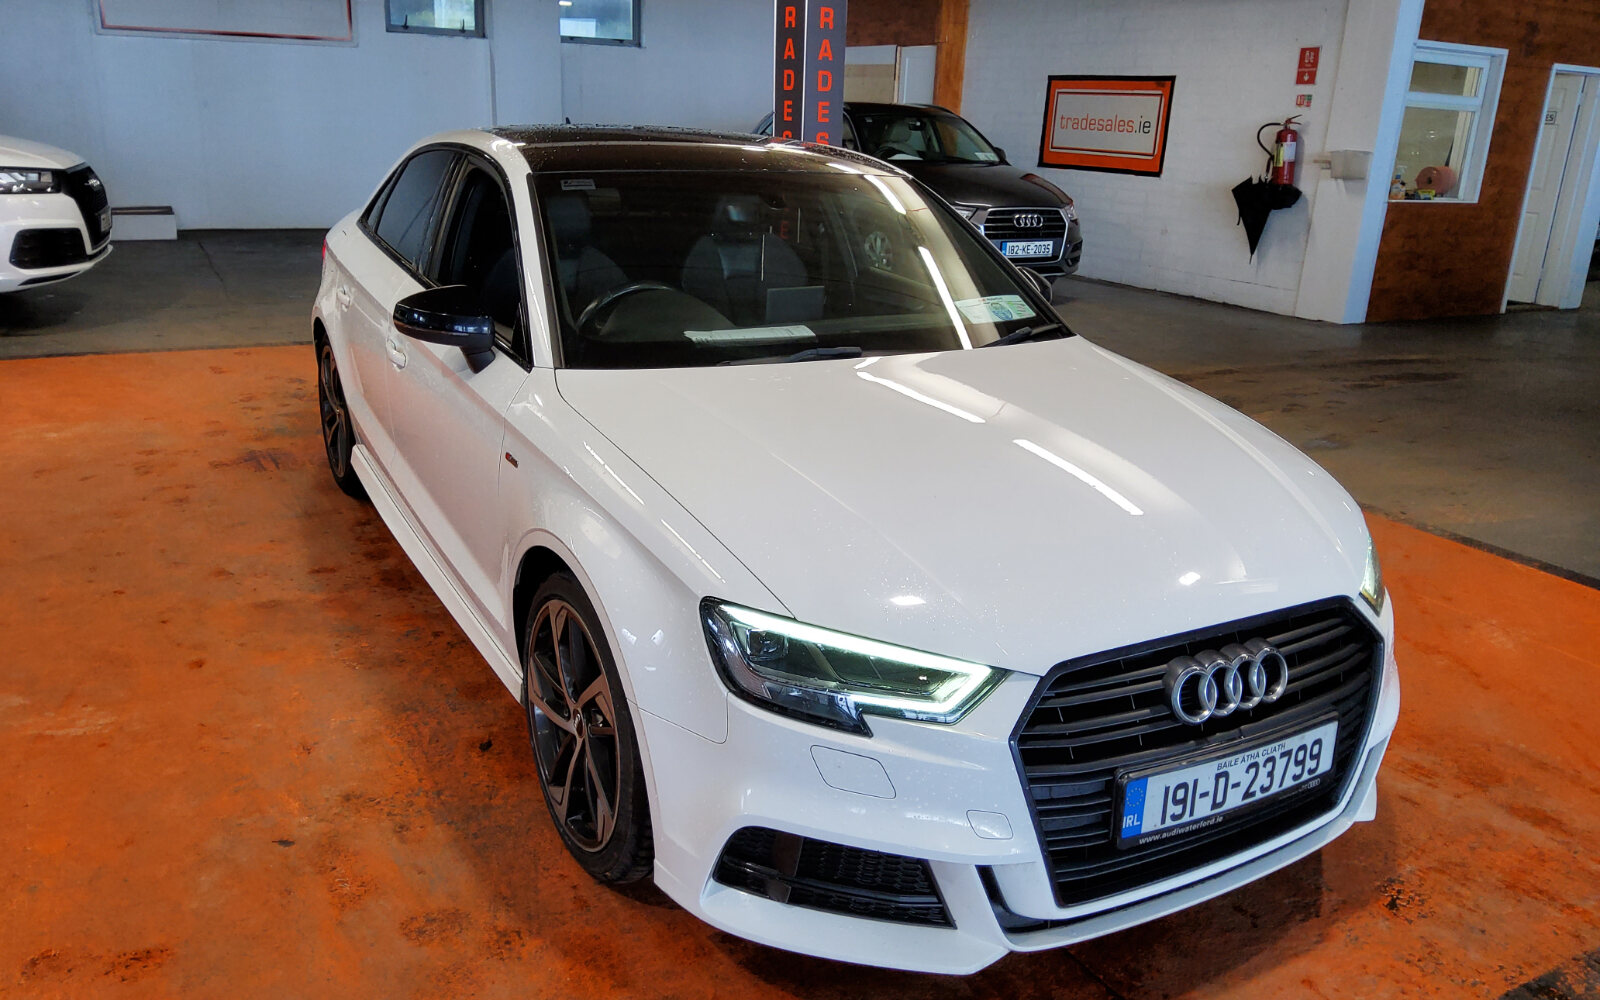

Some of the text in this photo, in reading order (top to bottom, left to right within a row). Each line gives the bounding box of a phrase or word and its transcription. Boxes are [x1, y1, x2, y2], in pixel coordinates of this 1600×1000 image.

[1060, 113, 1152, 134] tradesales.ie
[1008, 244, 1051, 255] 182-KE-2035
[1217, 758, 1239, 771] BAILE
[1262, 743, 1286, 757] CLIATH
[1160, 738, 1323, 826] 191-D-23799
[1123, 813, 1140, 829] IRL
[1139, 816, 1223, 845] www.audiwaterford.ie
